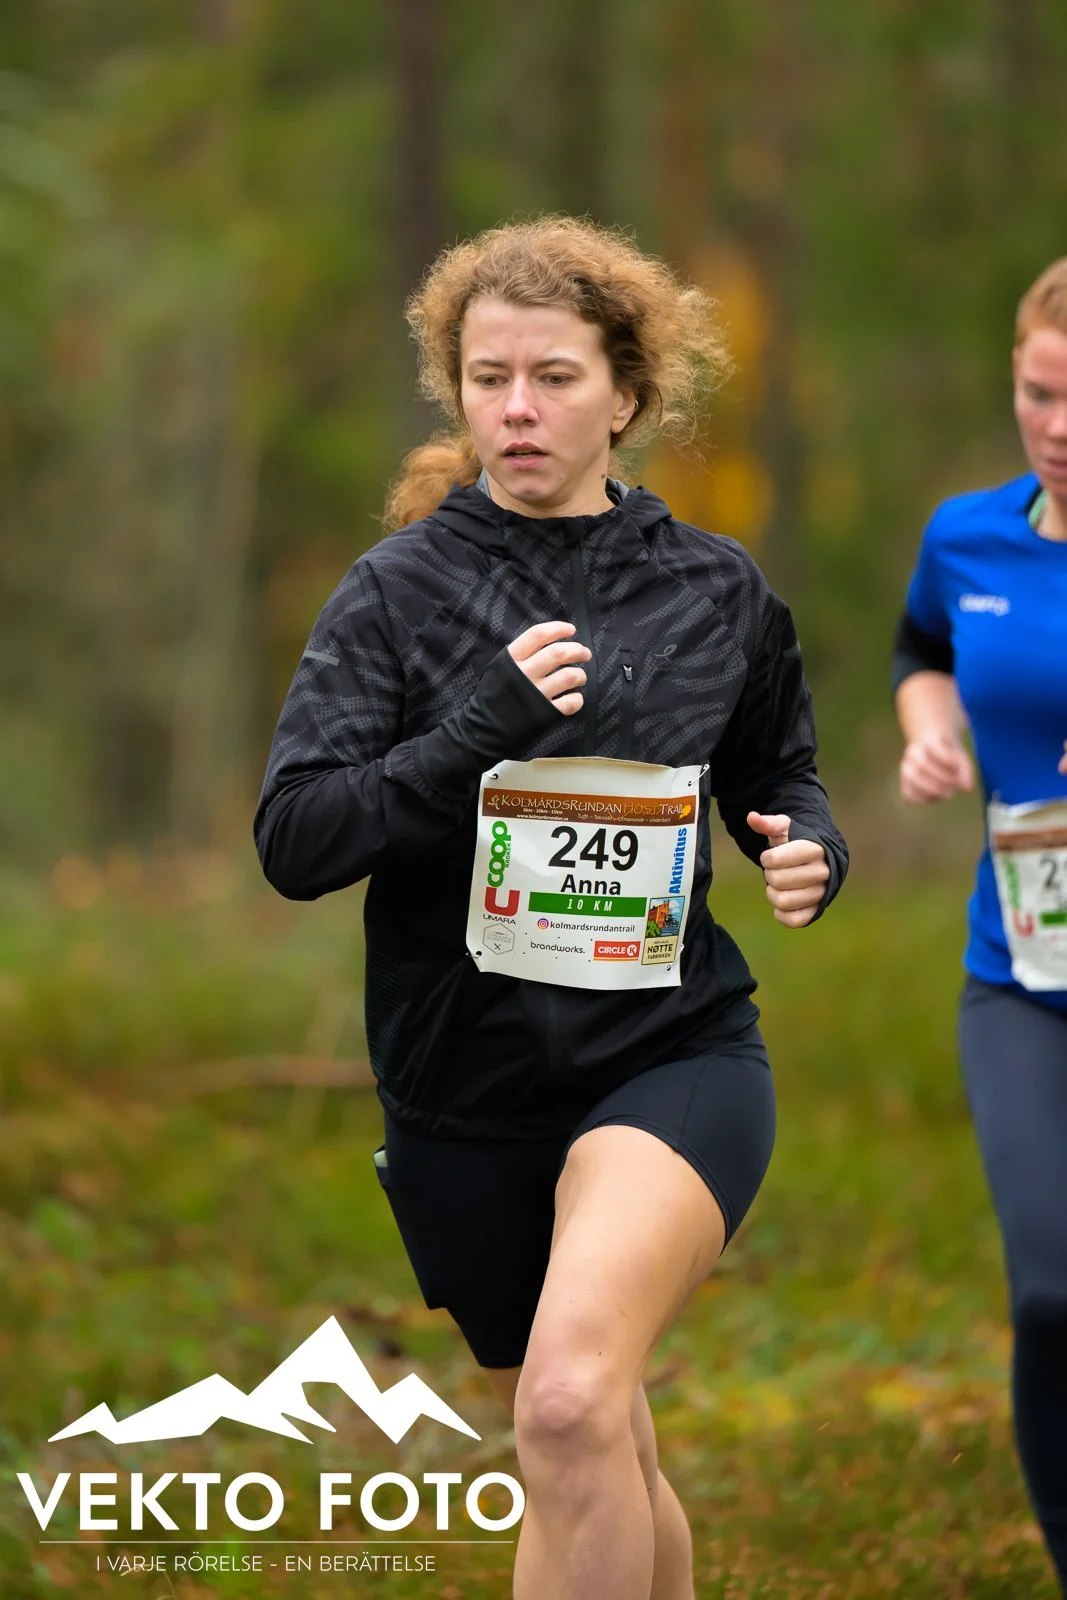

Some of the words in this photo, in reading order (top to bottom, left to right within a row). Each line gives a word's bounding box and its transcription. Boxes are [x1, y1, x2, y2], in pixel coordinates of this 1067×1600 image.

[548, 825, 639, 872] 249
[669, 827, 687, 894] Aktivitus
[560, 874, 622, 896] Anna
[567, 898, 584, 910] 10
[594, 900, 612, 912] KM
[482, 914, 516, 925] UMARA
[550, 921, 636, 932] kolmardsrundantrail
[598, 946, 626, 954] CIRCLE
[647, 944, 674, 954] NØTTE
